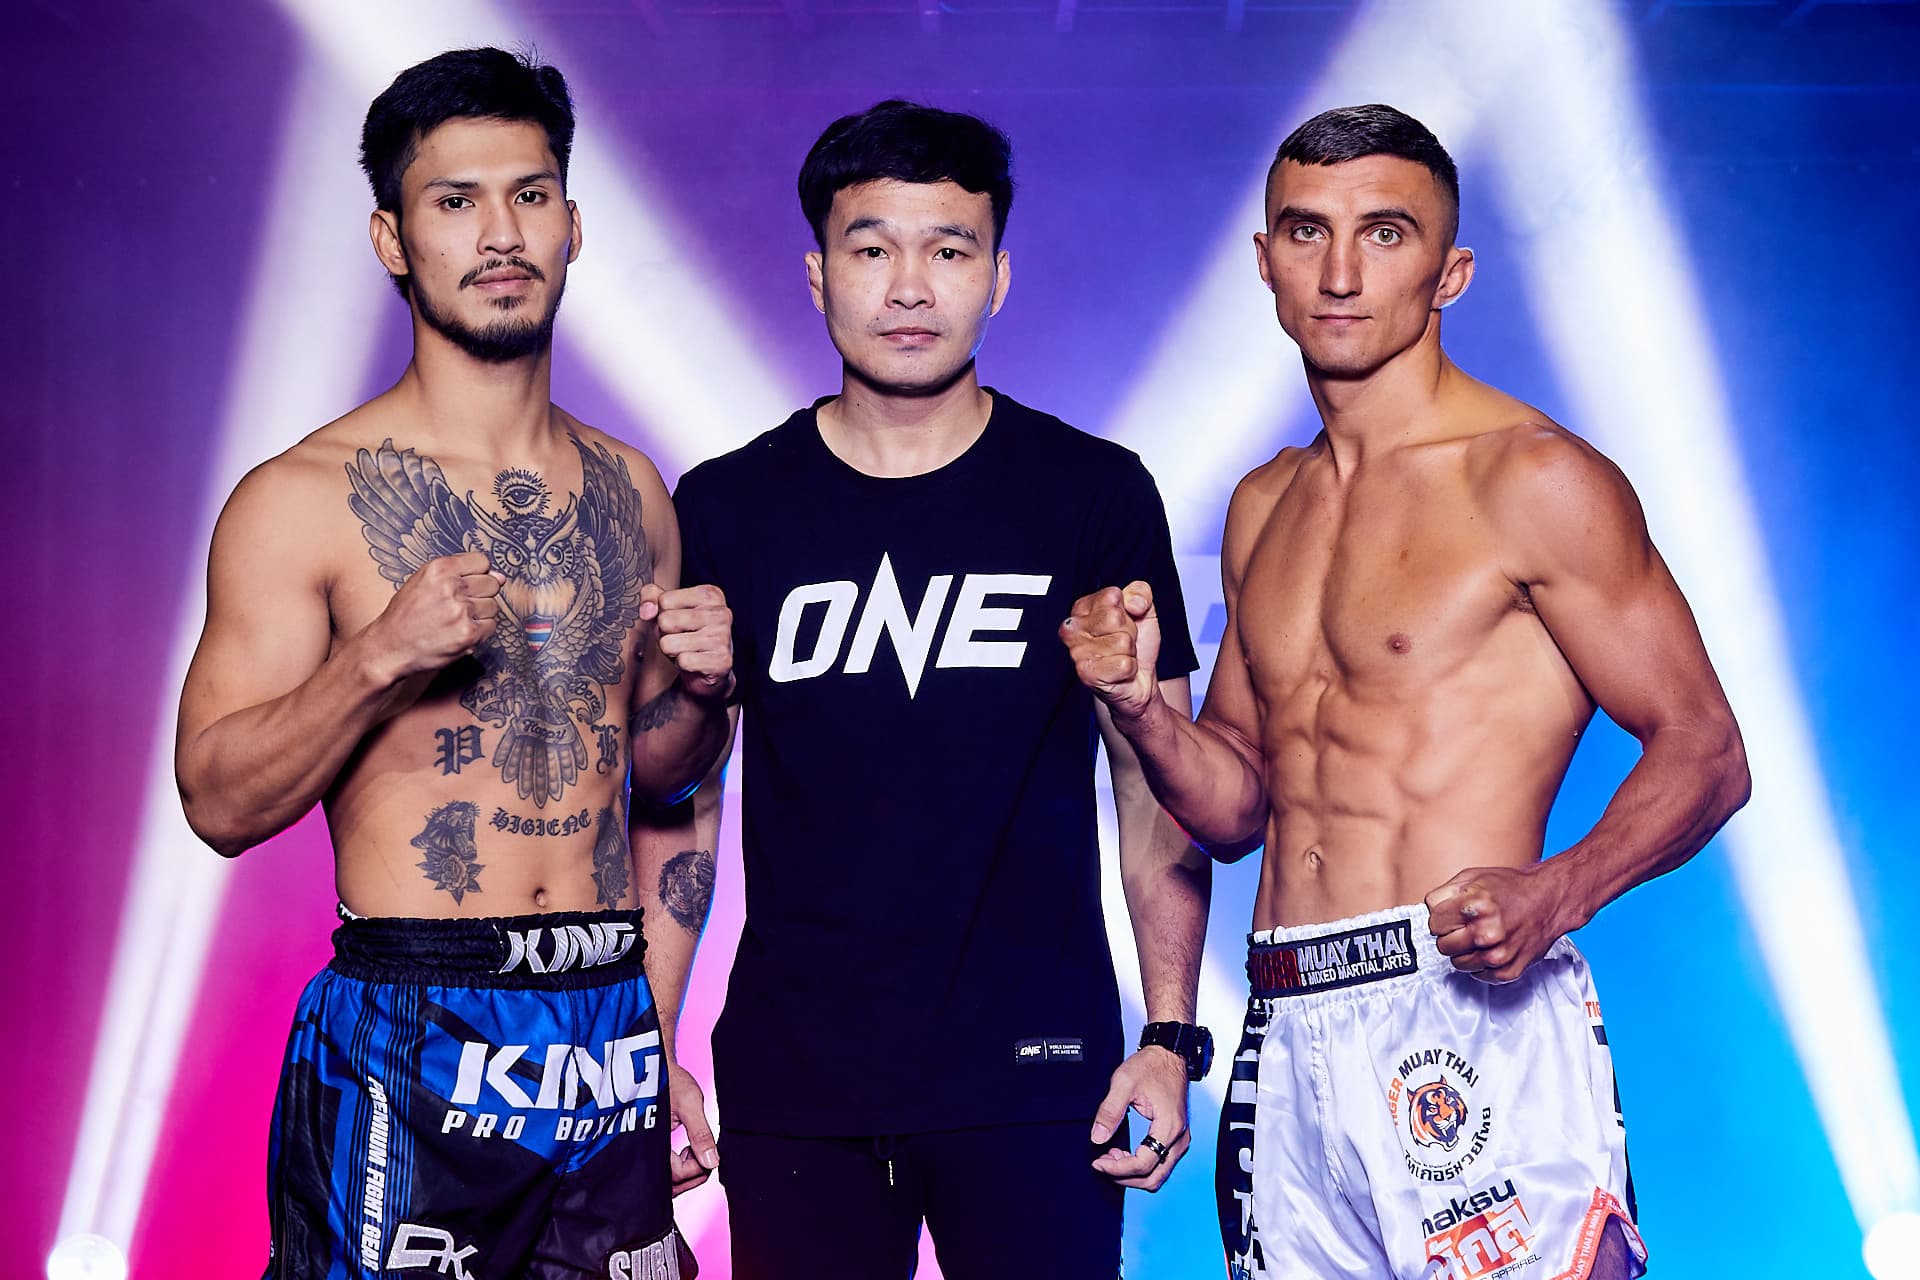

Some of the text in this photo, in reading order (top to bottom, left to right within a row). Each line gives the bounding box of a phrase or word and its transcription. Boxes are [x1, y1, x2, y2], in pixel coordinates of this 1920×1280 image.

[769, 552, 1052, 699] ONE
[499, 922, 636, 974] KING
[1297, 938, 1351, 972] MUAY
[1354, 927, 1408, 961] THAI
[1309, 968, 1337, 986] MIXED
[1337, 961, 1382, 980] MARTIAL
[1383, 953, 1412, 972] ARTS
[451, 1030, 660, 1110] KING
[1020, 1045, 1042, 1056] ONE
[1398, 1049, 1442, 1080] MUAY
[1445, 1051, 1479, 1088] THAI
[441, 1104, 657, 1142] PRO BOXING
[361, 1075, 390, 1272] PREMIUM FIGHT GEAR
